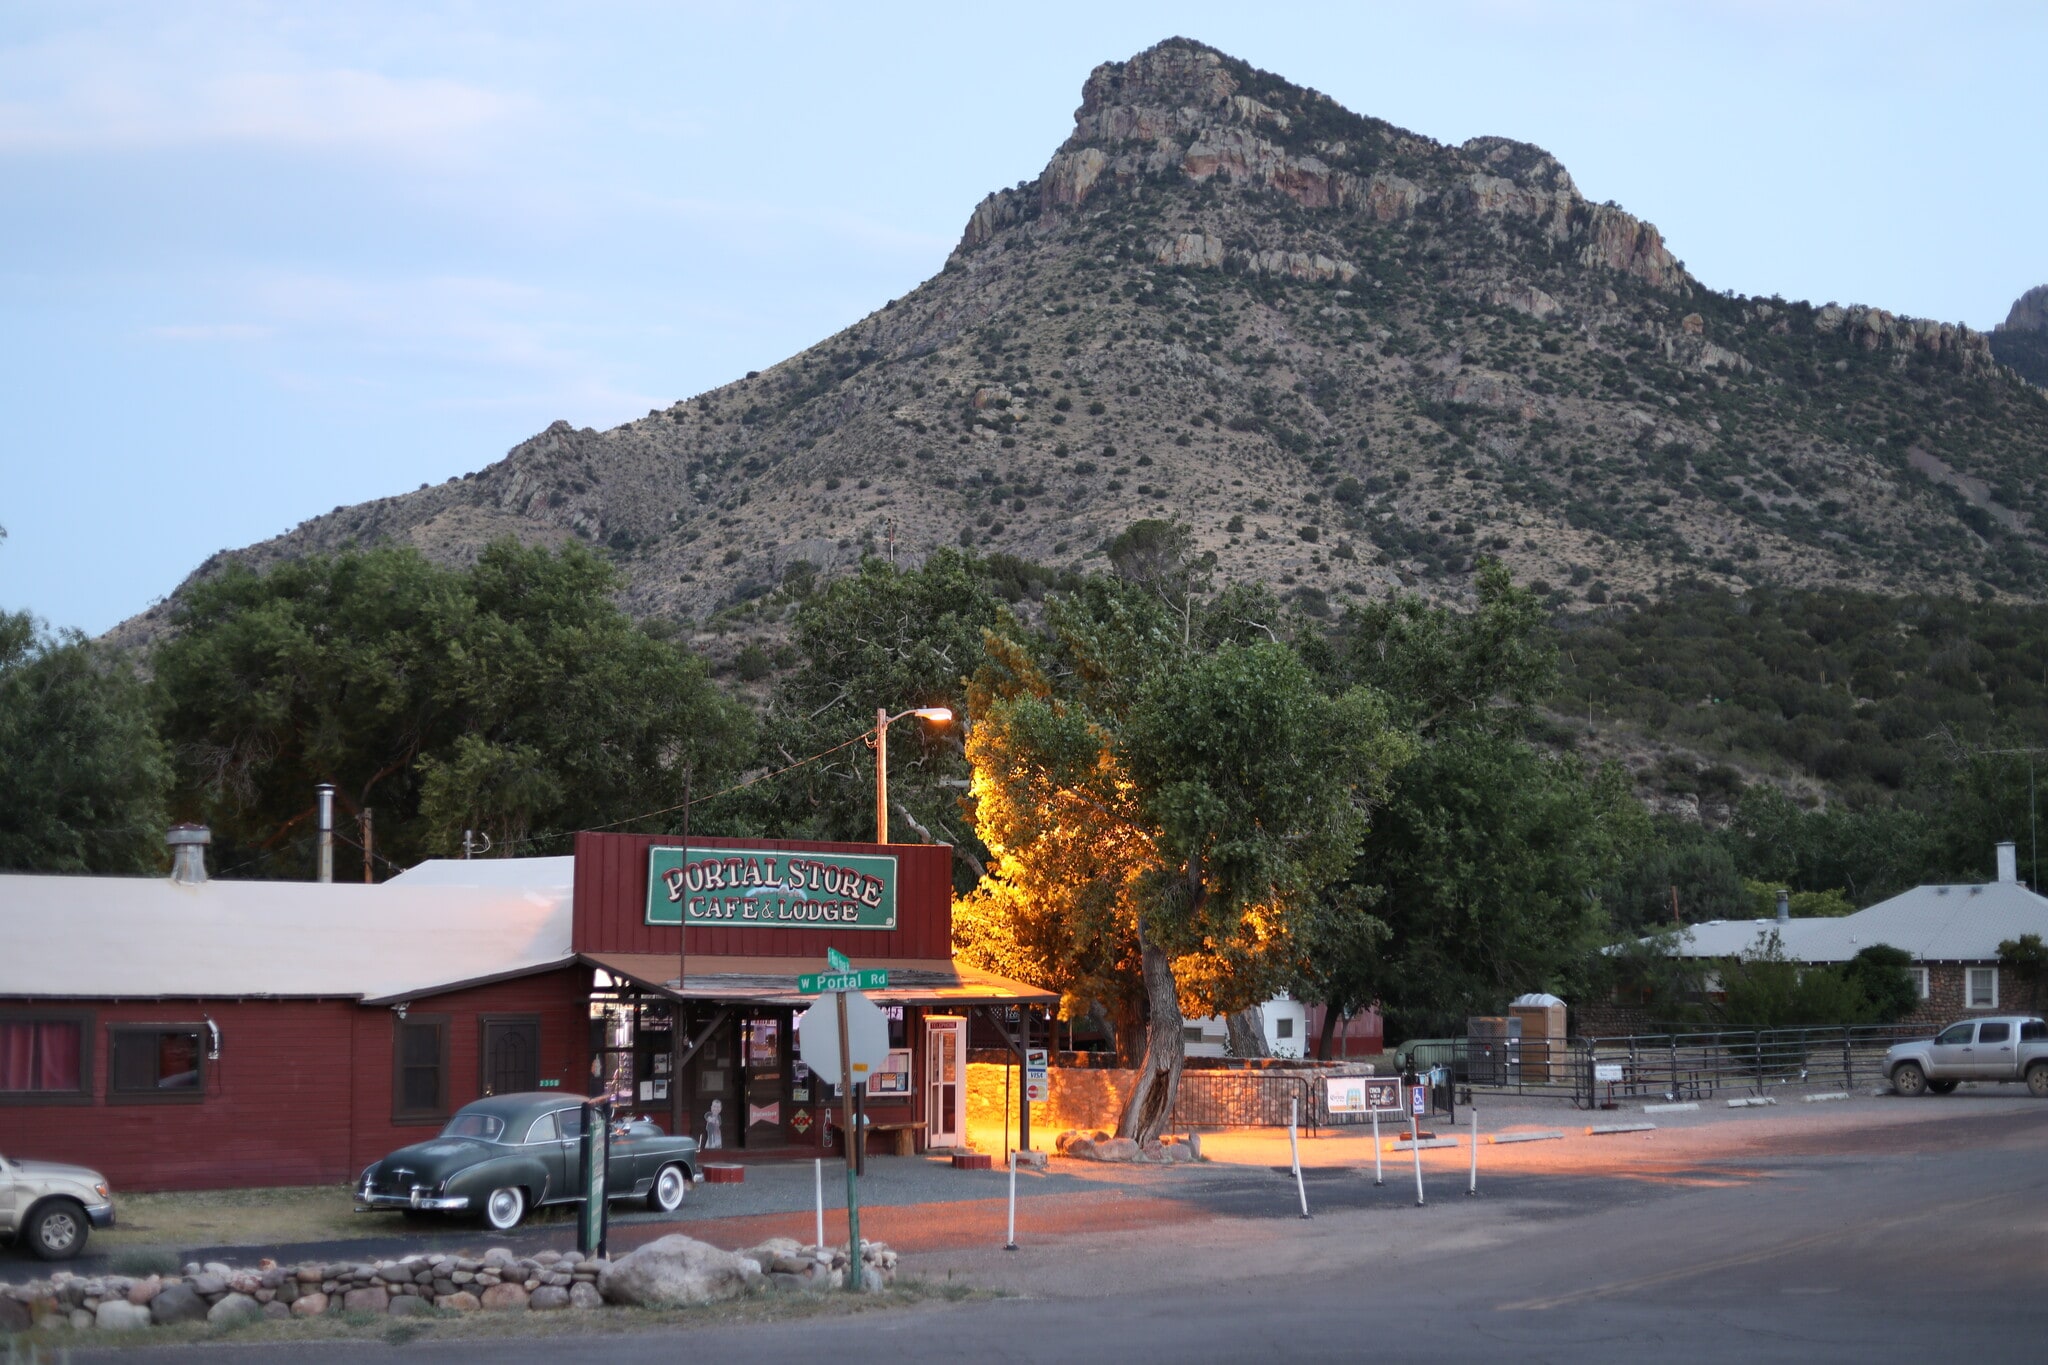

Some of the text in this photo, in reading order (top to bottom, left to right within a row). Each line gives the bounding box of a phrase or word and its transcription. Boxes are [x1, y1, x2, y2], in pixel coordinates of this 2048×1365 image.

[663, 857, 884, 908] PORTAL STORE
[689, 896, 859, 922] CAFE & LODGE
[801, 973, 886, 990] W Portal Rd
